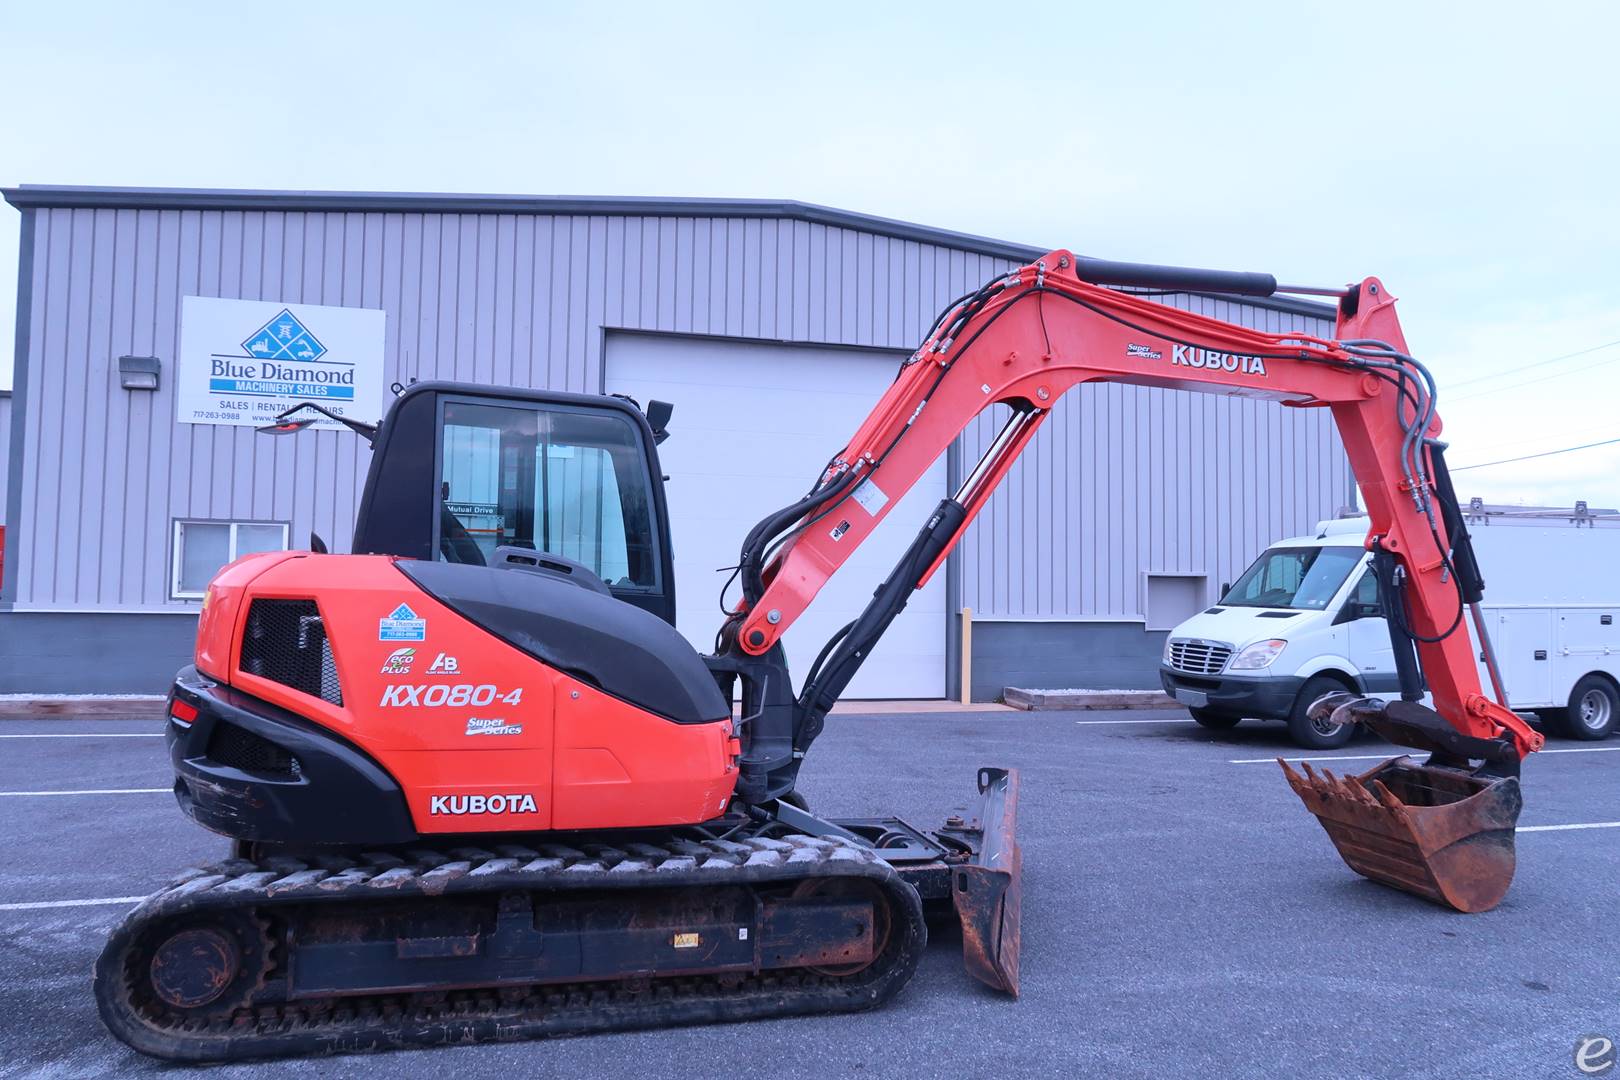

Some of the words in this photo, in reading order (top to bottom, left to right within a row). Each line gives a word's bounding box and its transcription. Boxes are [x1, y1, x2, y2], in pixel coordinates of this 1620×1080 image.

[1128, 343, 1151, 352] Super
[1172, 344, 1266, 376] KUBOTA
[211, 359, 256, 379] Blue
[261, 362, 354, 385] Diamond
[235, 380, 294, 394] MACHINERY
[296, 384, 328, 396] SALES
[219, 400, 249, 410] SALES
[306, 404, 344, 415] REAIRS
[193, 410, 240, 420] 717-263-0988
[447, 505, 472, 513] Mutual
[474, 506, 494, 514] Drive
[380, 666, 411, 674] PLUS
[379, 684, 523, 707] KX080-4
[467, 717, 505, 729] Super
[478, 725, 522, 735] Series
[430, 794, 538, 815] KUBOTA
